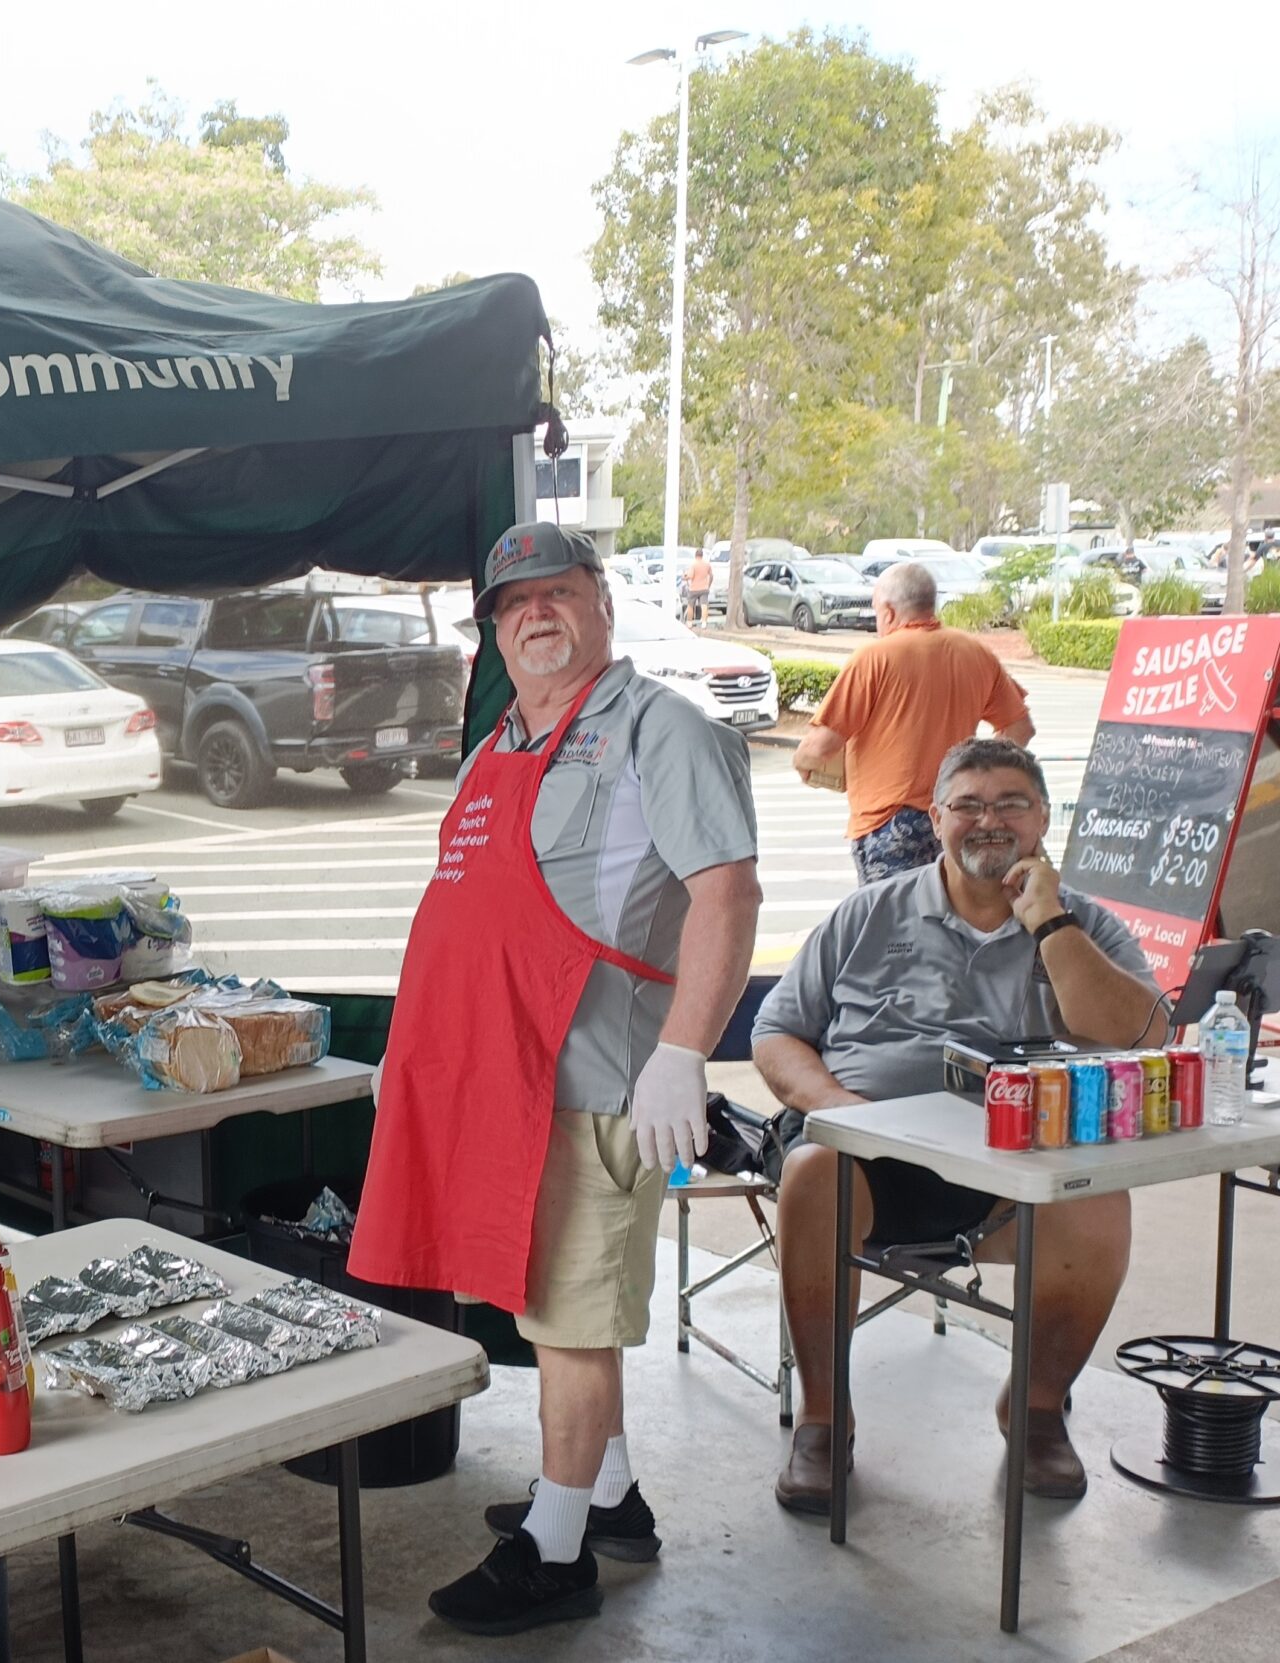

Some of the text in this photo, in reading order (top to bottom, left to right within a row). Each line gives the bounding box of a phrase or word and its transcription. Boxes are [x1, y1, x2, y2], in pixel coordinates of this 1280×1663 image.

[1132, 622, 1249, 677] SAUSAGE
[1122, 674, 1200, 717] SIZZLE
[1132, 918, 1153, 938] For
[1154, 923, 1187, 948] Local
[1143, 950, 1170, 971] ups
